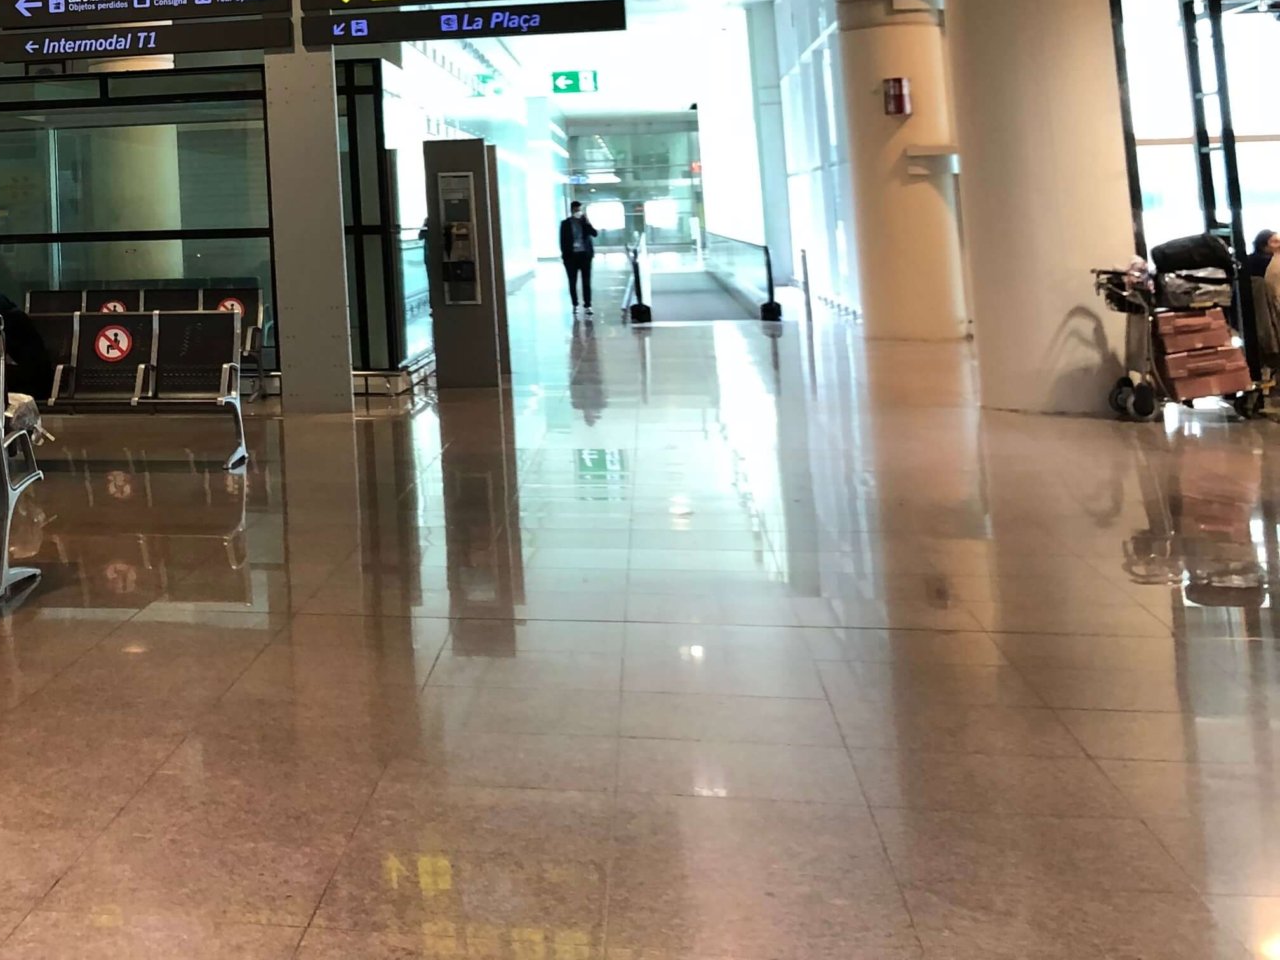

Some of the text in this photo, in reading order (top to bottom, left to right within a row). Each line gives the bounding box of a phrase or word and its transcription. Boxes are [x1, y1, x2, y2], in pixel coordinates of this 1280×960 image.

[68, 1, 128, 12] Objetos perdidos
[462, 11, 540, 31] La Plaça
[42, 31, 157, 55] Intermodal T1
